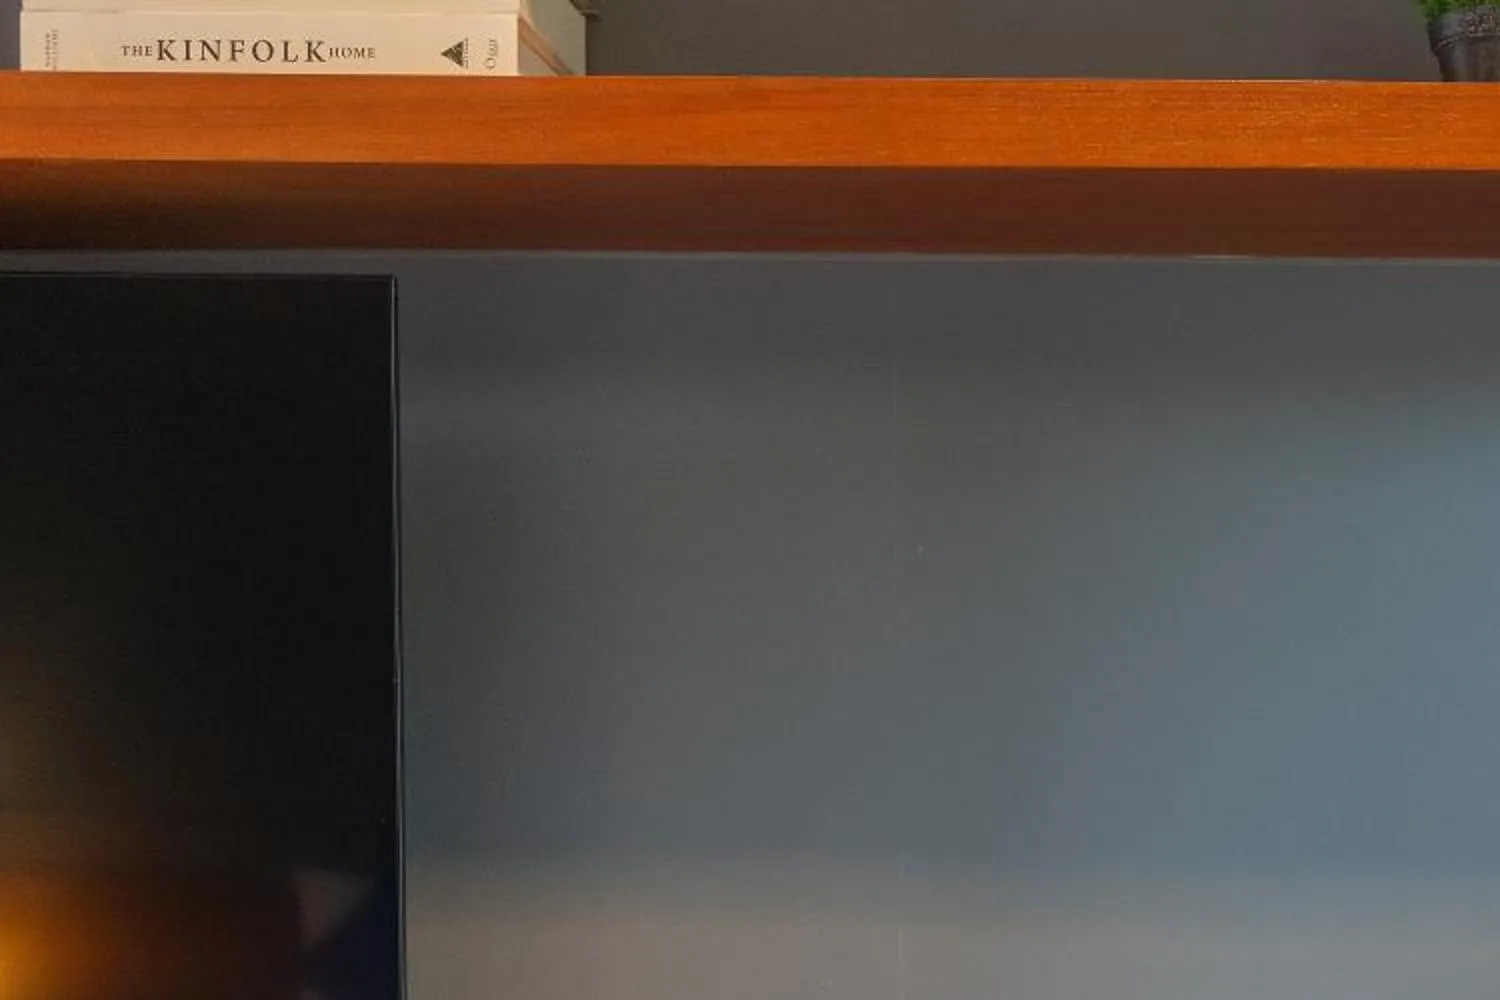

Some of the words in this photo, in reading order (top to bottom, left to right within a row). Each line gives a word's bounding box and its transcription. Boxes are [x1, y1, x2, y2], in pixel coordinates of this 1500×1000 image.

[121, 45, 152, 56] THE
[156, 39, 327, 62] KINFOLK
[328, 47, 376, 58] HOME
